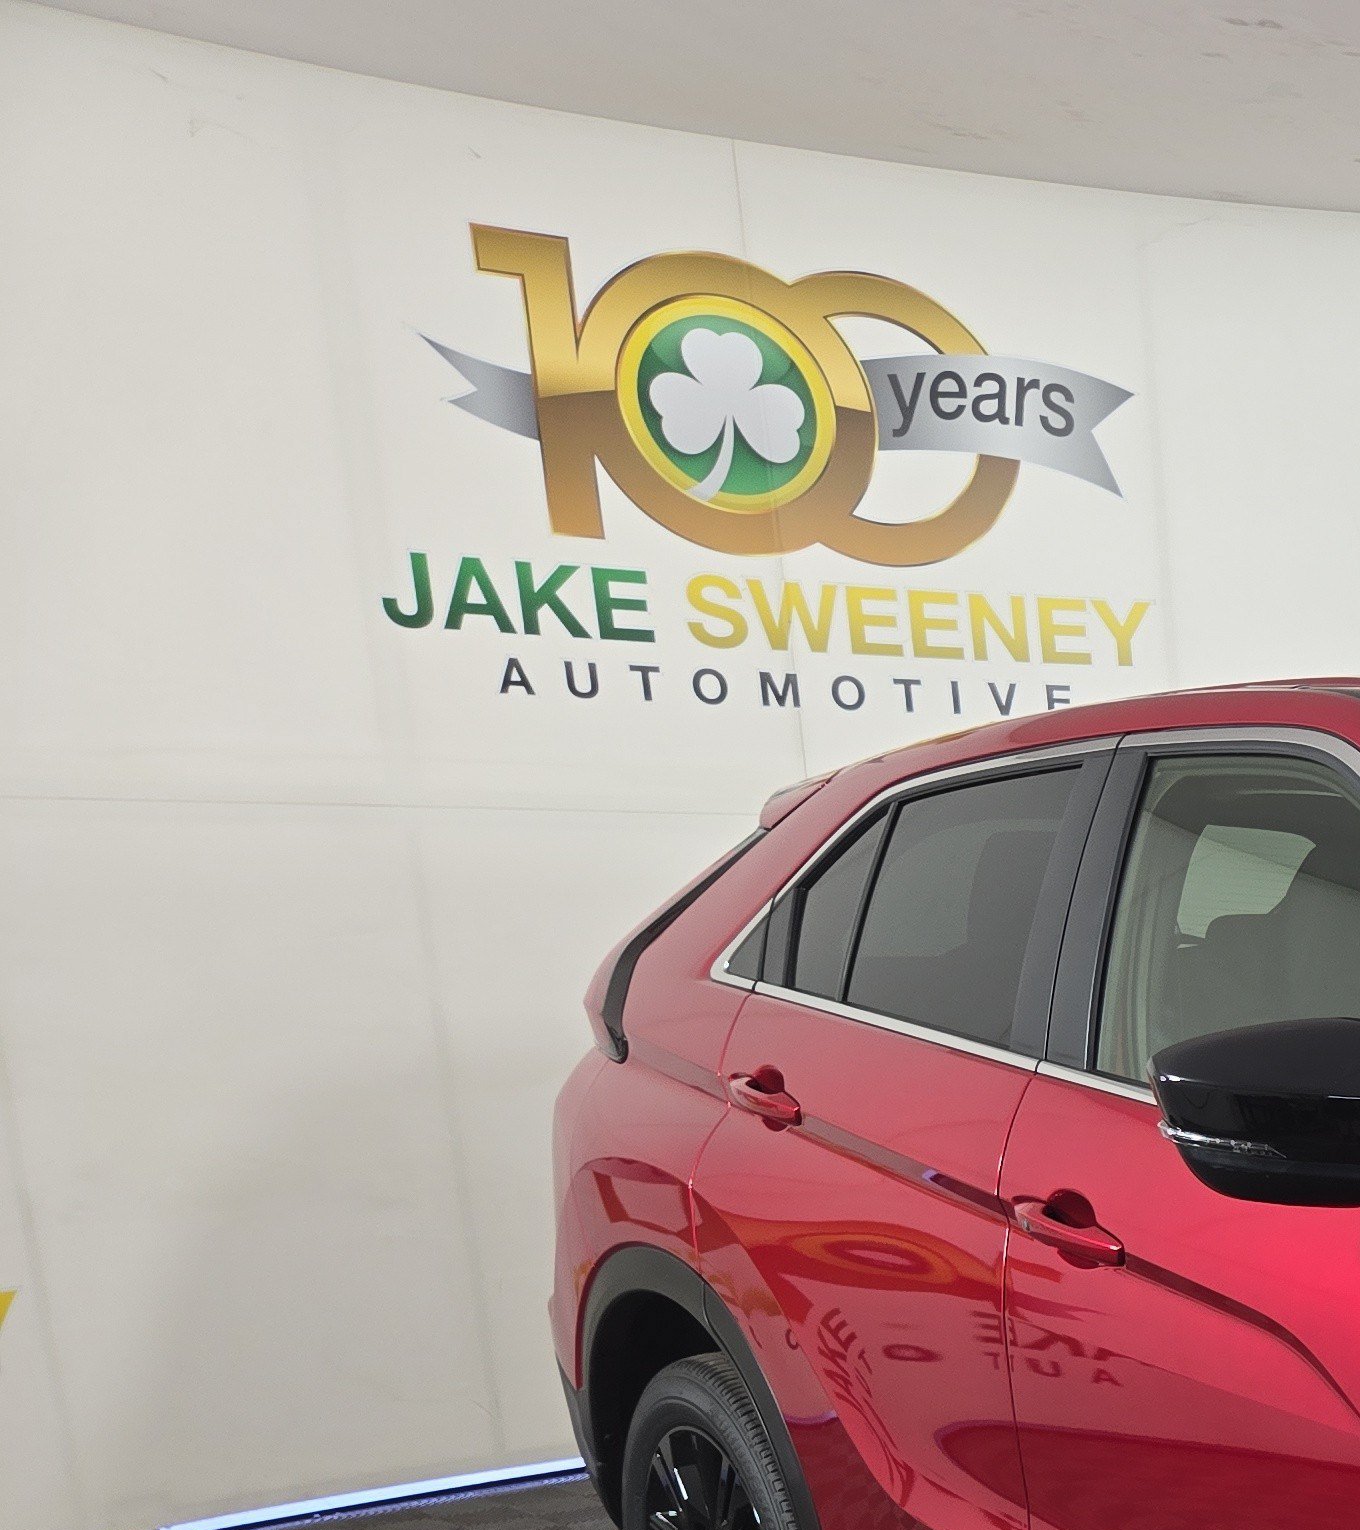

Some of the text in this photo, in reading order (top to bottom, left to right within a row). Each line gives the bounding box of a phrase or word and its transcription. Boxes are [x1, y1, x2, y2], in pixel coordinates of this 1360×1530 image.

[468, 222, 1077, 567] 100 years
[382, 551, 1151, 667] JAKE SWEENEY
